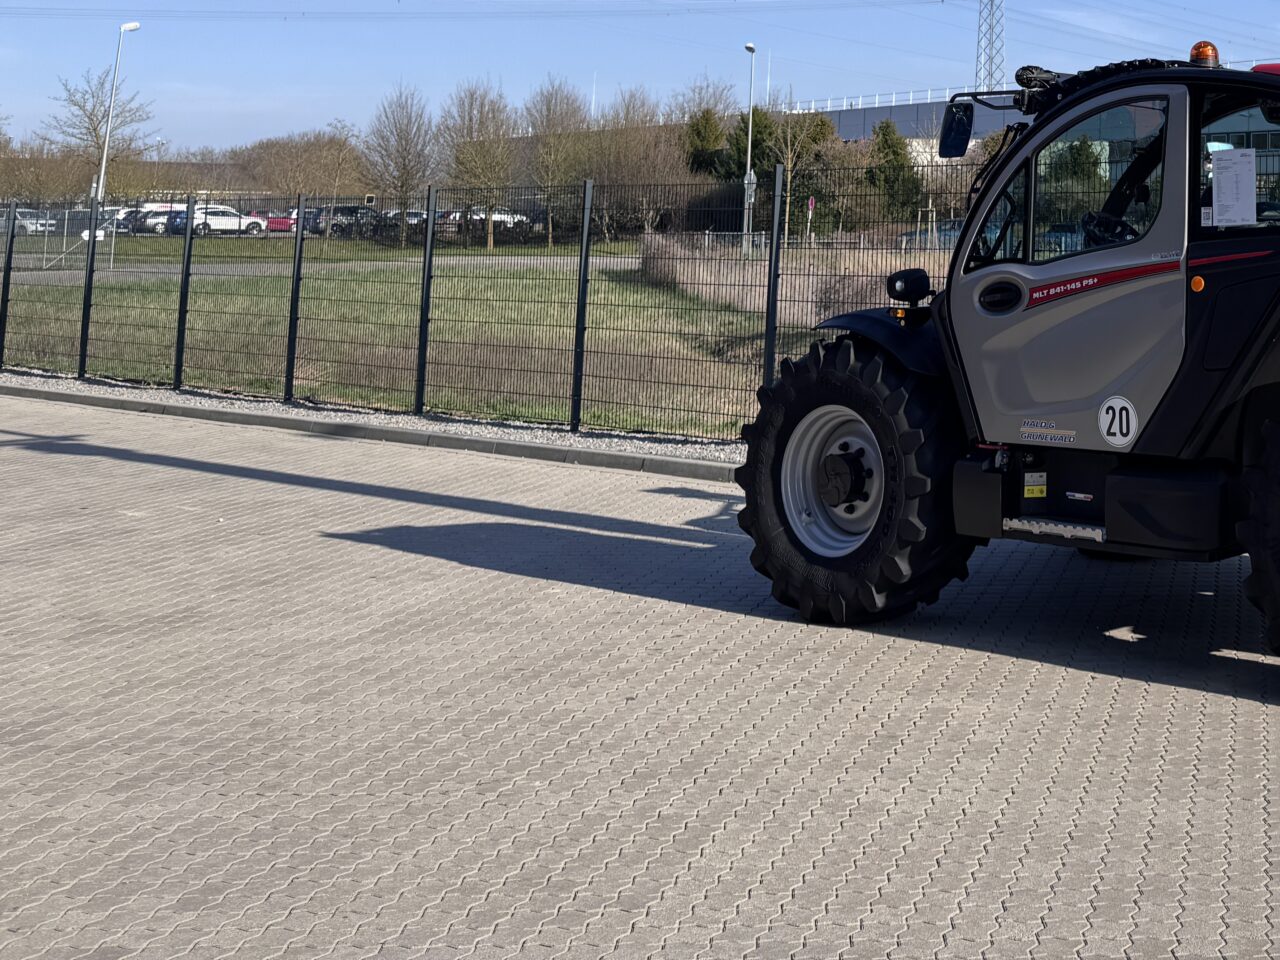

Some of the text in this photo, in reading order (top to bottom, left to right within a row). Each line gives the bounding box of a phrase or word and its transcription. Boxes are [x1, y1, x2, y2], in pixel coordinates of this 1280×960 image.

[1032, 277, 1098, 299] MLT 841-145 PS+
[1022, 420, 1046, 429] HALD
[1105, 405, 1130, 438] 20
